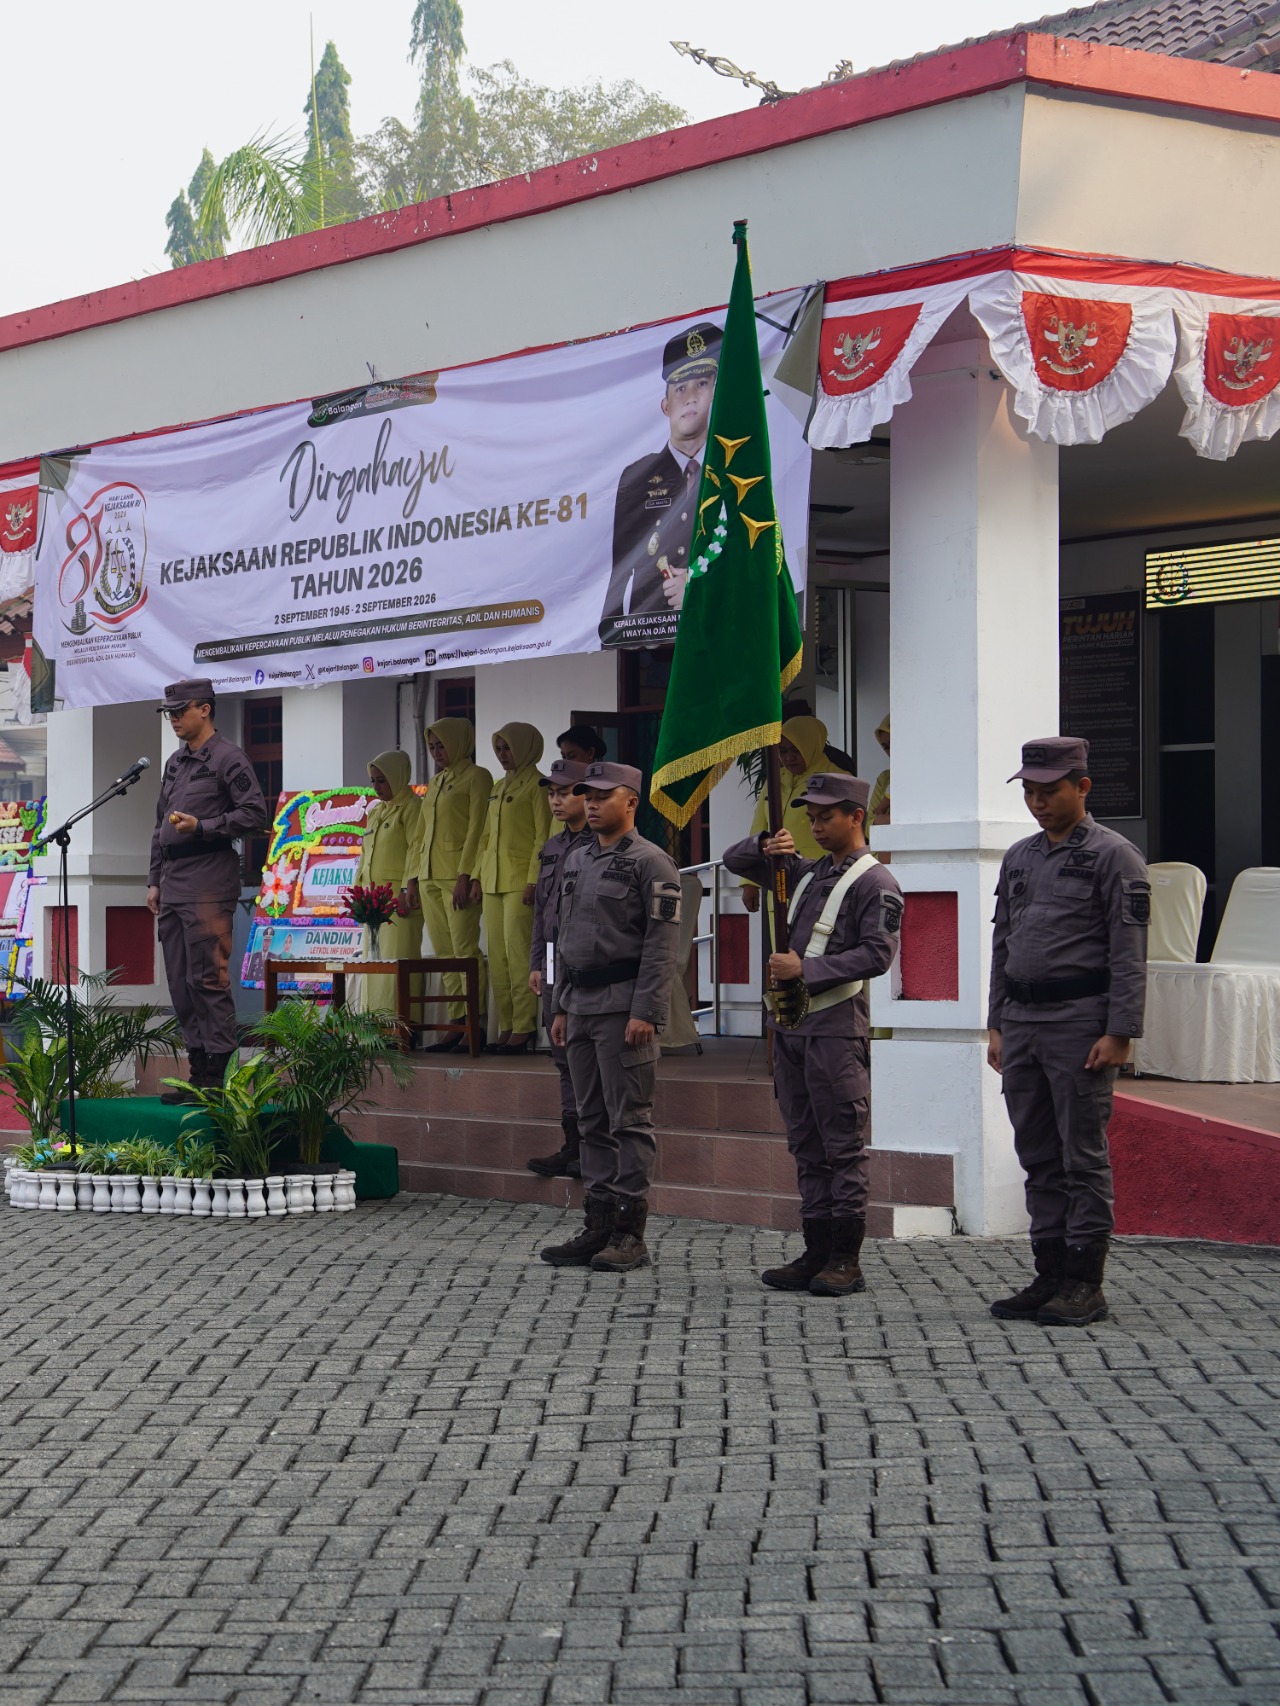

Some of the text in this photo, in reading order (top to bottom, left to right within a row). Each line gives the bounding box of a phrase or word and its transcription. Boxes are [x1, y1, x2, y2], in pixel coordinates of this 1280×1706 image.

[328, 402, 362, 415] Balangan
[280, 418, 455, 523] Dirgahayu
[104, 499, 135, 512] KEJAKSAAN
[160, 492, 588, 586] KEJAKSAAN REPUBLIK INDONESIA KE-81
[291, 556, 423, 600] TAHUN 2026
[274, 614, 280, 625] 2
[280, 608, 328, 624] SEPTEMBER
[329, 604, 350, 618] 1945
[355, 603, 361, 614] 2
[361, 596, 412, 613] SEPTEMBER
[413, 592, 437, 606] 2026
[613, 618, 636, 629] KEPALA
[637, 614, 677, 626] KEJAKSAAN
[1063, 610, 1136, 636] TUJUH
[196, 606, 540, 659] MENGEMBALIKAN KEPERCAYAAN PUBLIK MELALUI PENEGAKAN HUKUM BERINTEGRITAS, ADIL DAN HUMANIS
[626, 628, 652, 638] WAYAN
[653, 627, 667, 635] OJA
[1062, 630, 1135, 643] PERINTAH HARIAN
[228, 674, 252, 684] Balangan
[305, 795, 368, 833] Selamat
[311, 868, 354, 887] KEJAKSA
[305, 931, 354, 946] DANDIM
